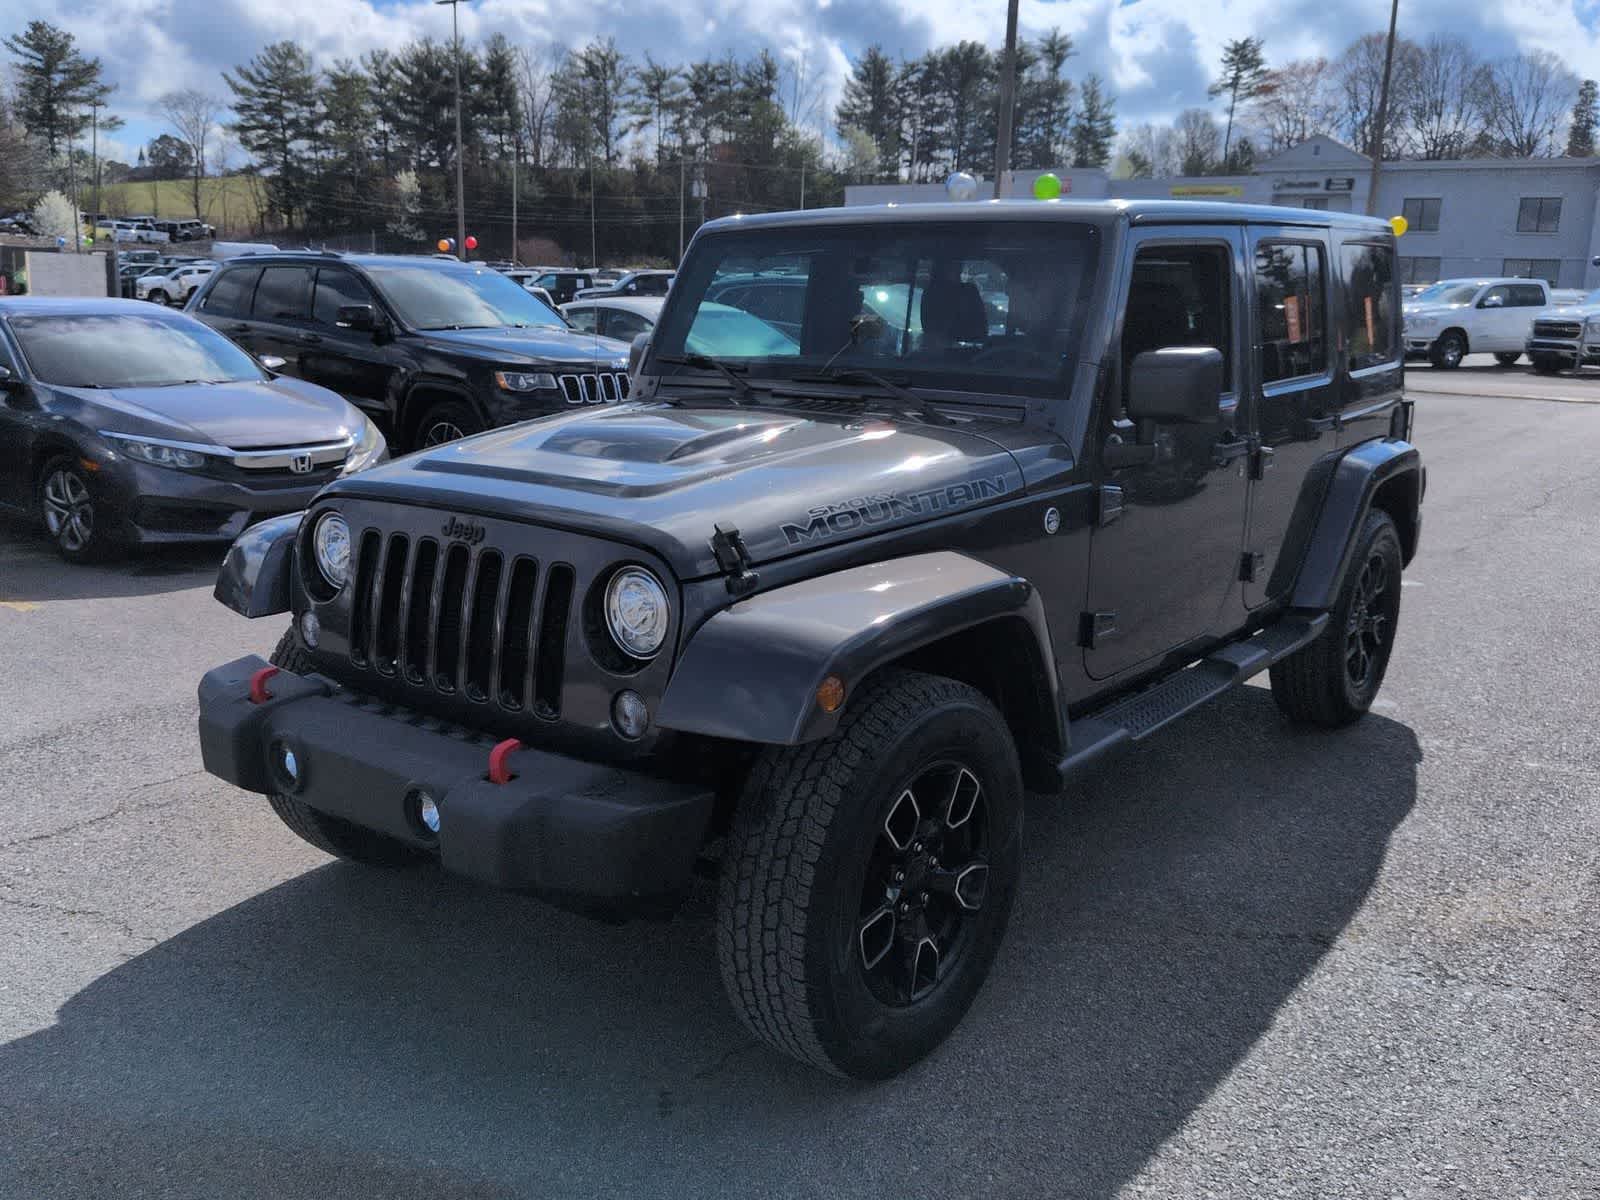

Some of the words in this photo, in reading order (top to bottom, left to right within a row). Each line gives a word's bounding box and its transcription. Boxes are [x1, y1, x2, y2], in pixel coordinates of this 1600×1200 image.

[780, 476, 1008, 545] MOUNTAIN
[807, 489, 897, 519] SMOKY
[441, 516, 485, 545] Jeep
